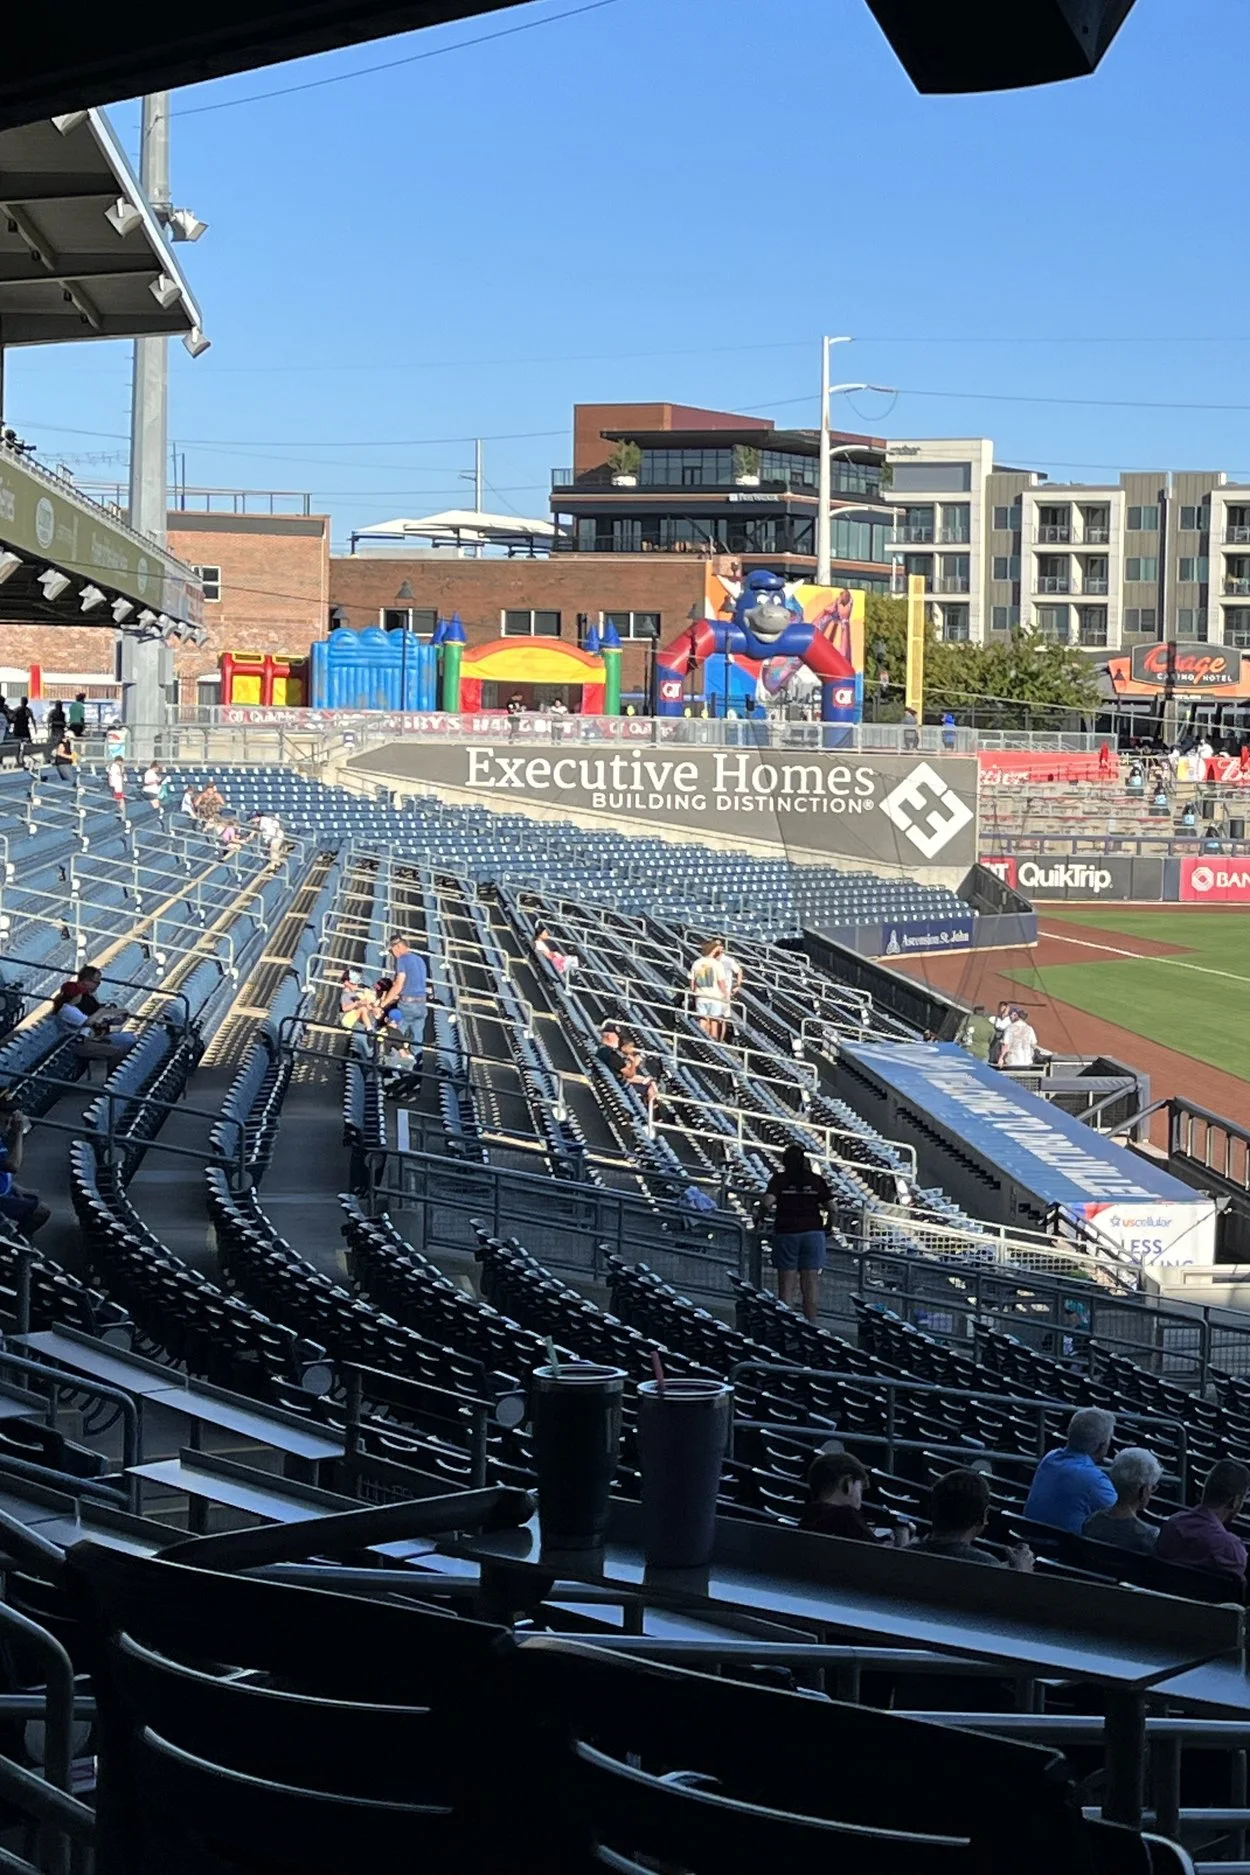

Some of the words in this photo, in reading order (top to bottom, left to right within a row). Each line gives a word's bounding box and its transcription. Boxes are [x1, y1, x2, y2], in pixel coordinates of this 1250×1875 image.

[662, 683, 682, 698] QT
[835, 690, 852, 705] QT
[464, 747, 698, 792] Executive
[712, 753, 876, 797] Homes
[592, 792, 706, 811] BUILDING
[1018, 862, 1113, 893] QuikTrip
[901, 933, 940, 947] Ascension
[950, 930, 969, 943] John
[1122, 1216, 1173, 1228] uscellular
